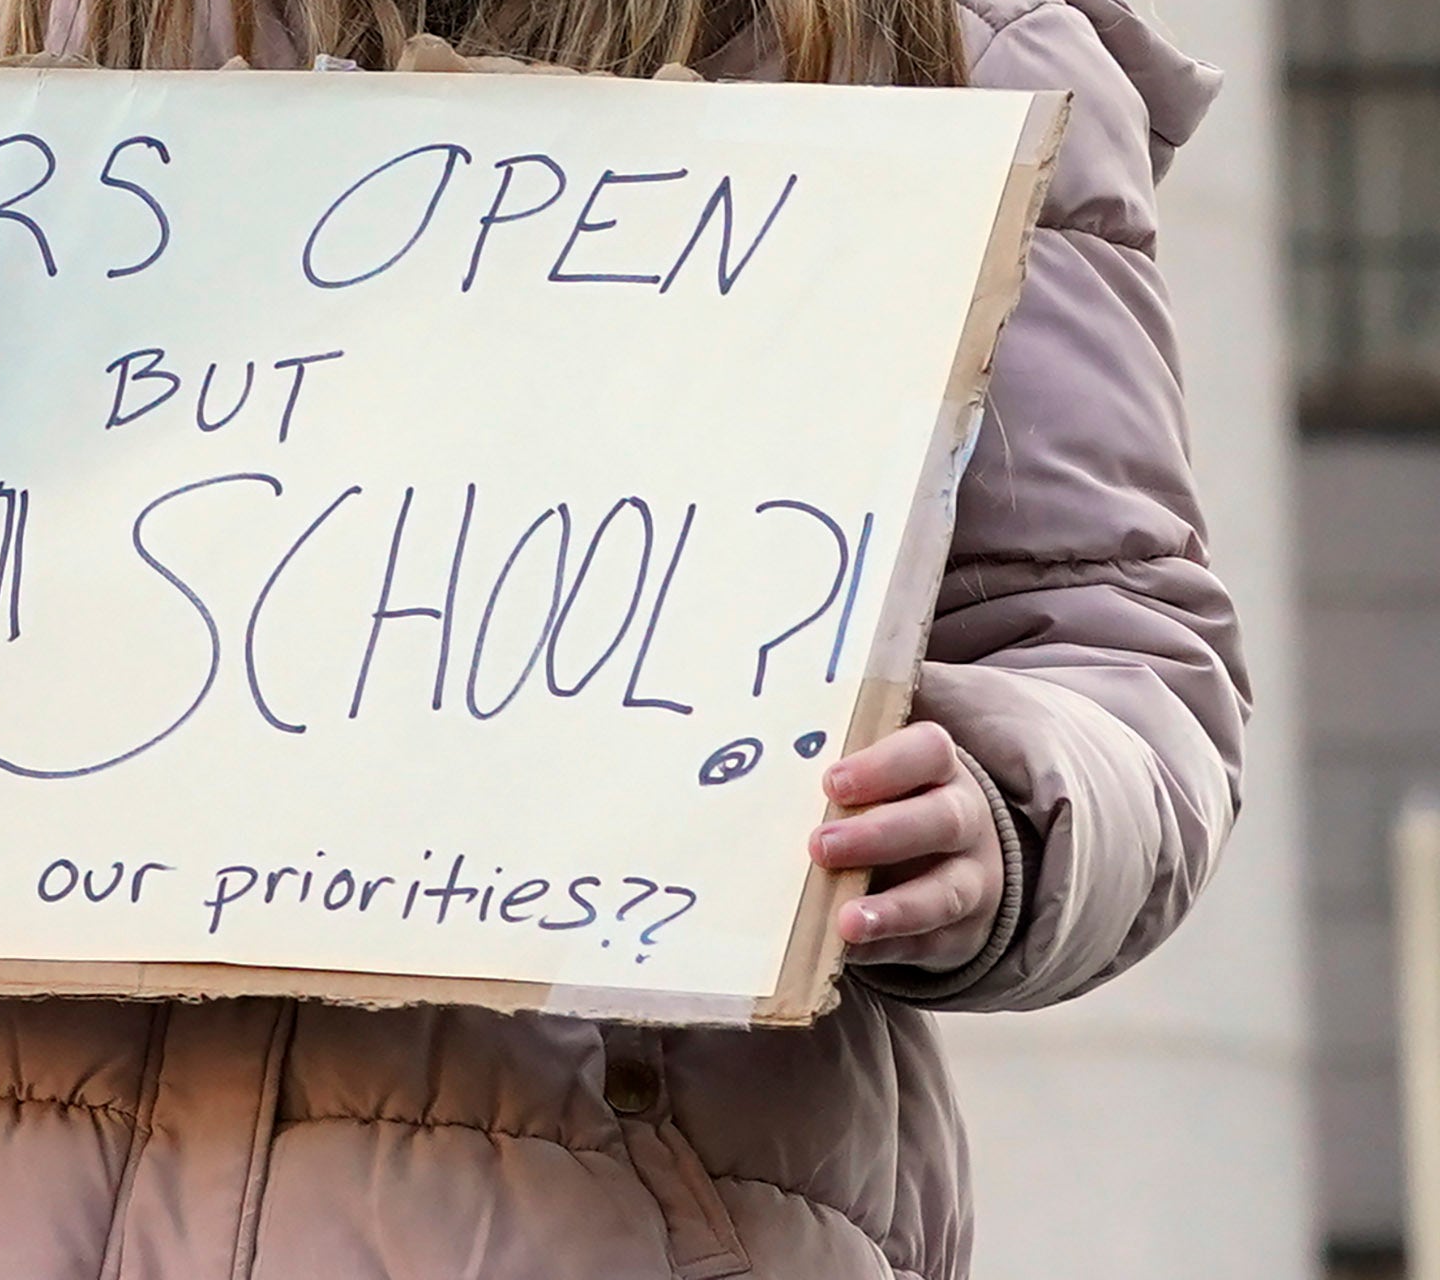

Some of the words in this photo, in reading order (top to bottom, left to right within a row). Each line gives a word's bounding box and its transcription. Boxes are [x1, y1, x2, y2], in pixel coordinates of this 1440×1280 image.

[301, 142, 798, 298] OPEN
[104, 348, 347, 436] BUT
[36, 860, 178, 907] our
[202, 850, 700, 968] priorities??
